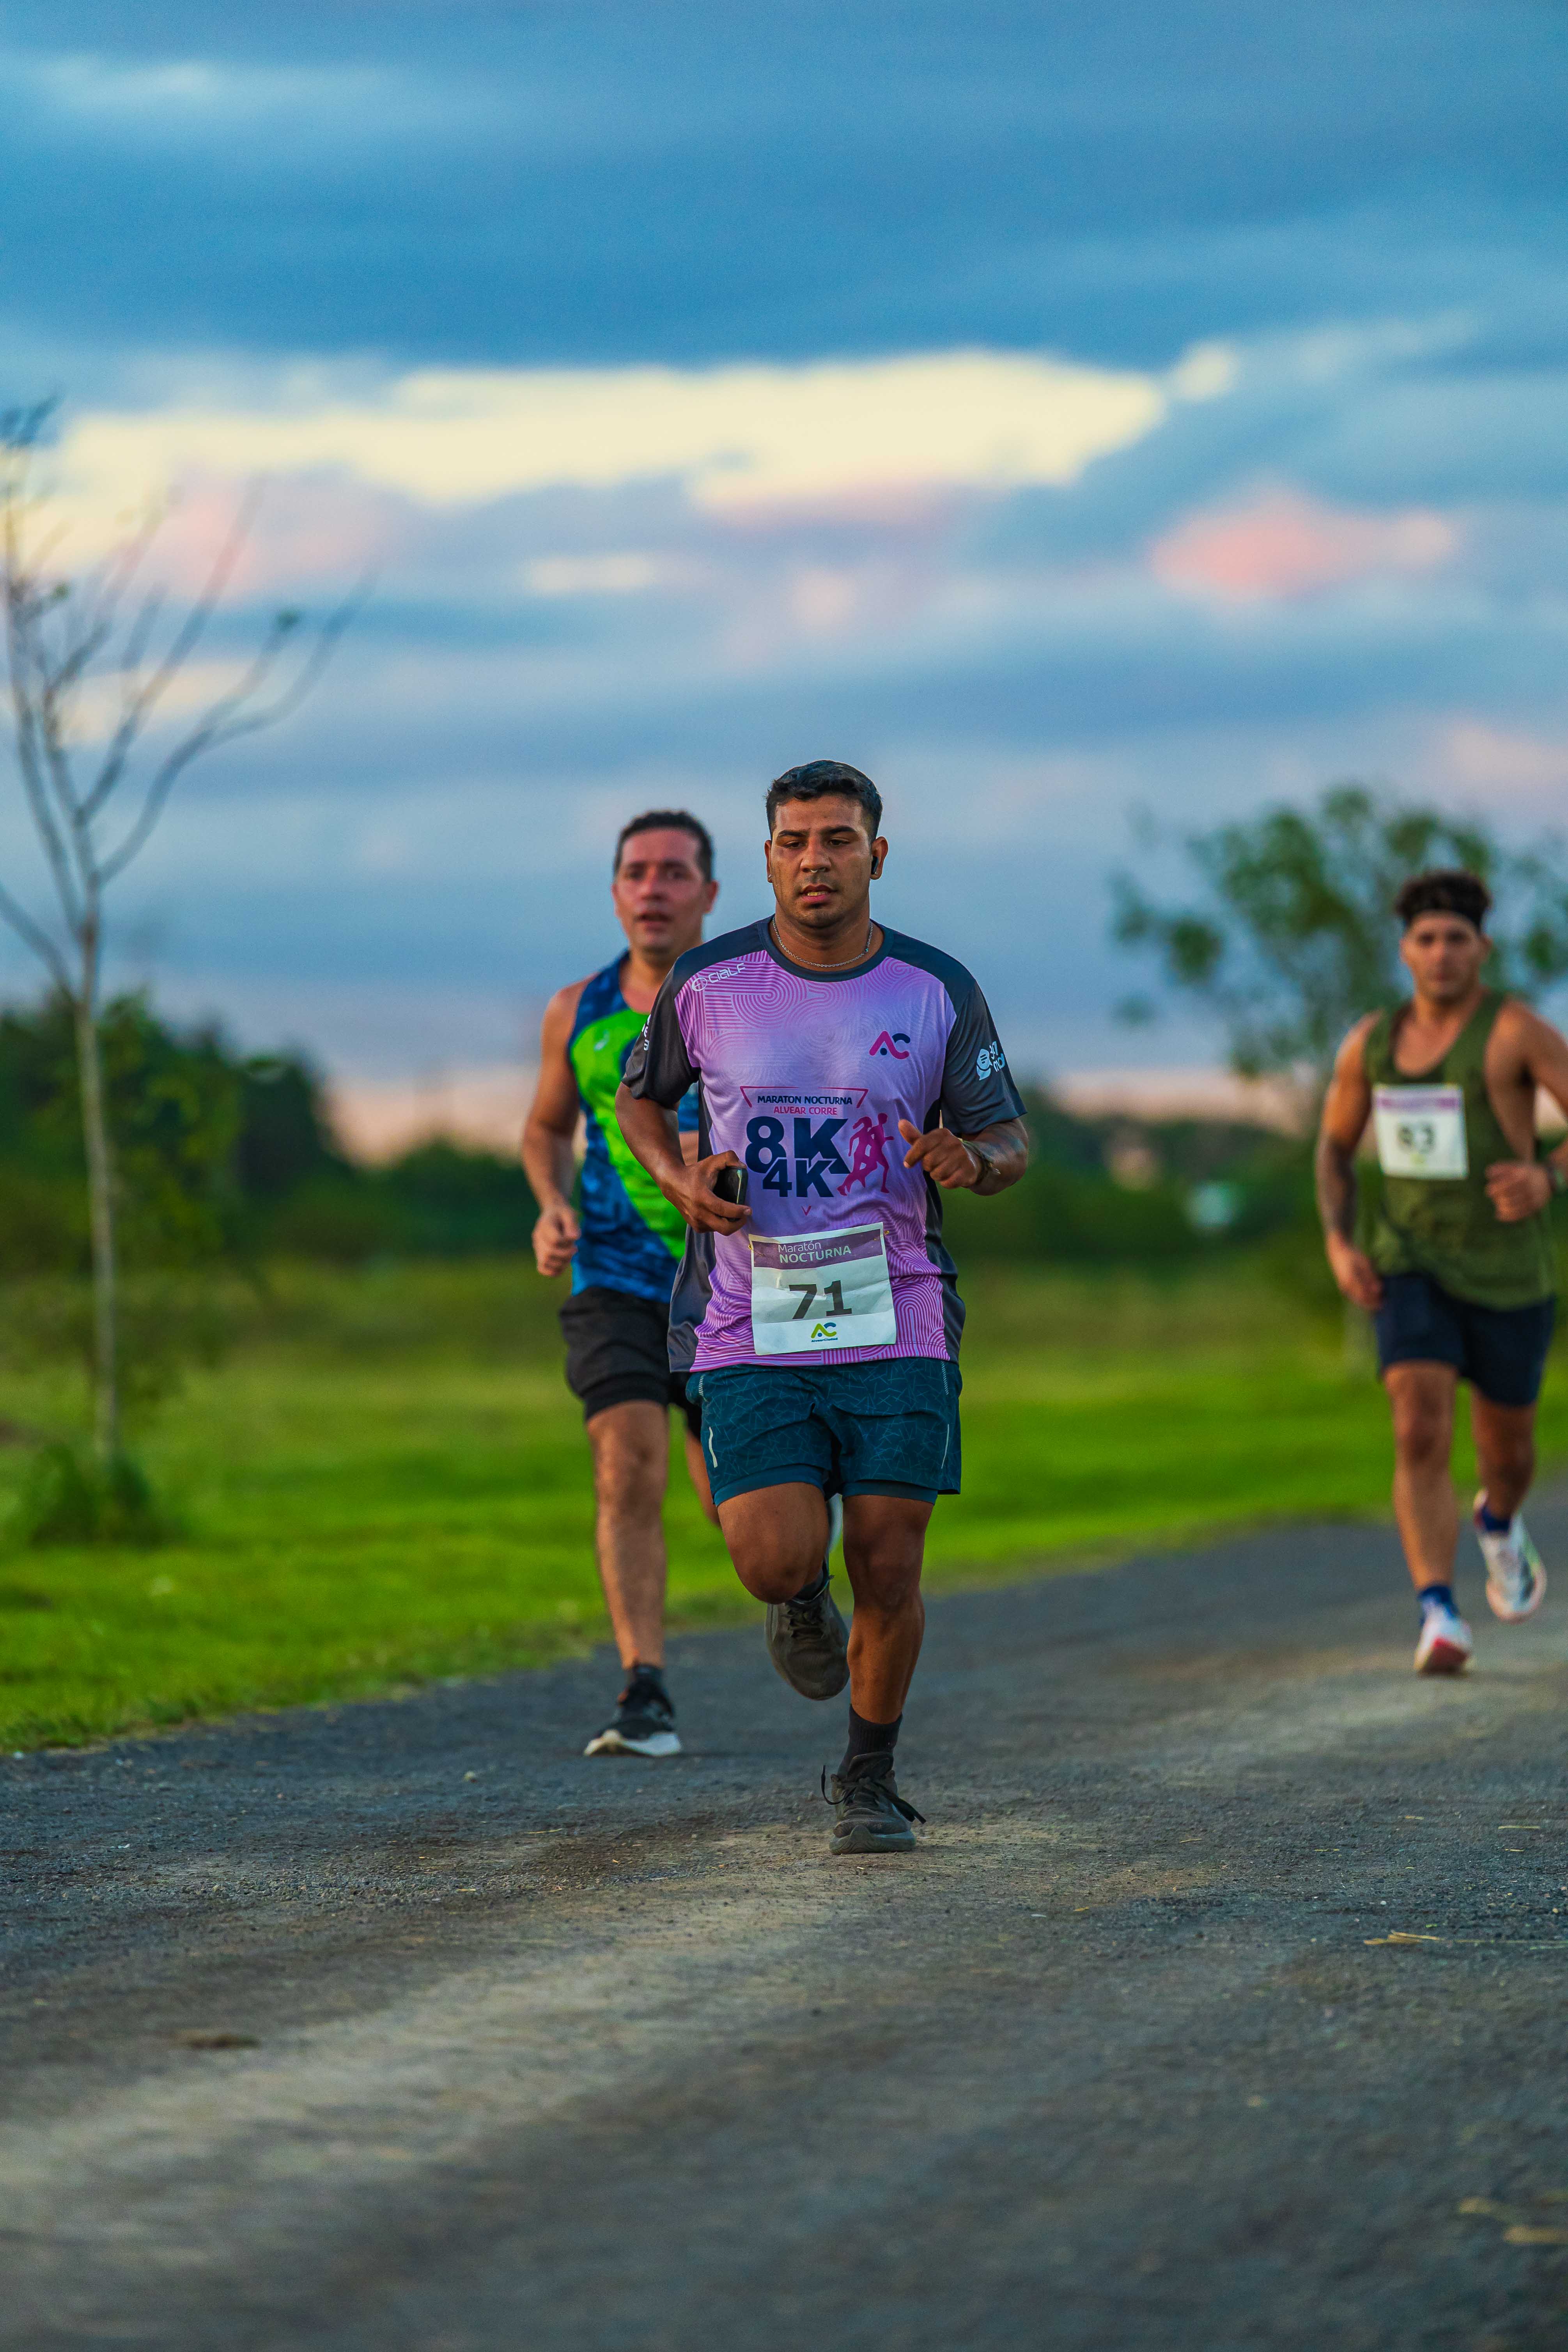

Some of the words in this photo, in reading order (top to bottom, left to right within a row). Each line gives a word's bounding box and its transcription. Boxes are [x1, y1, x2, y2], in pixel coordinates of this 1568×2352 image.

[804, 1096, 852, 1104] NOCTURNA
[745, 1116, 851, 1174] 8K
[762, 1159, 834, 1197] 4K
[778, 1240, 821, 1253] Maratón
[780, 1245, 852, 1263] NOCTURNA
[788, 1280, 852, 1319] 71
